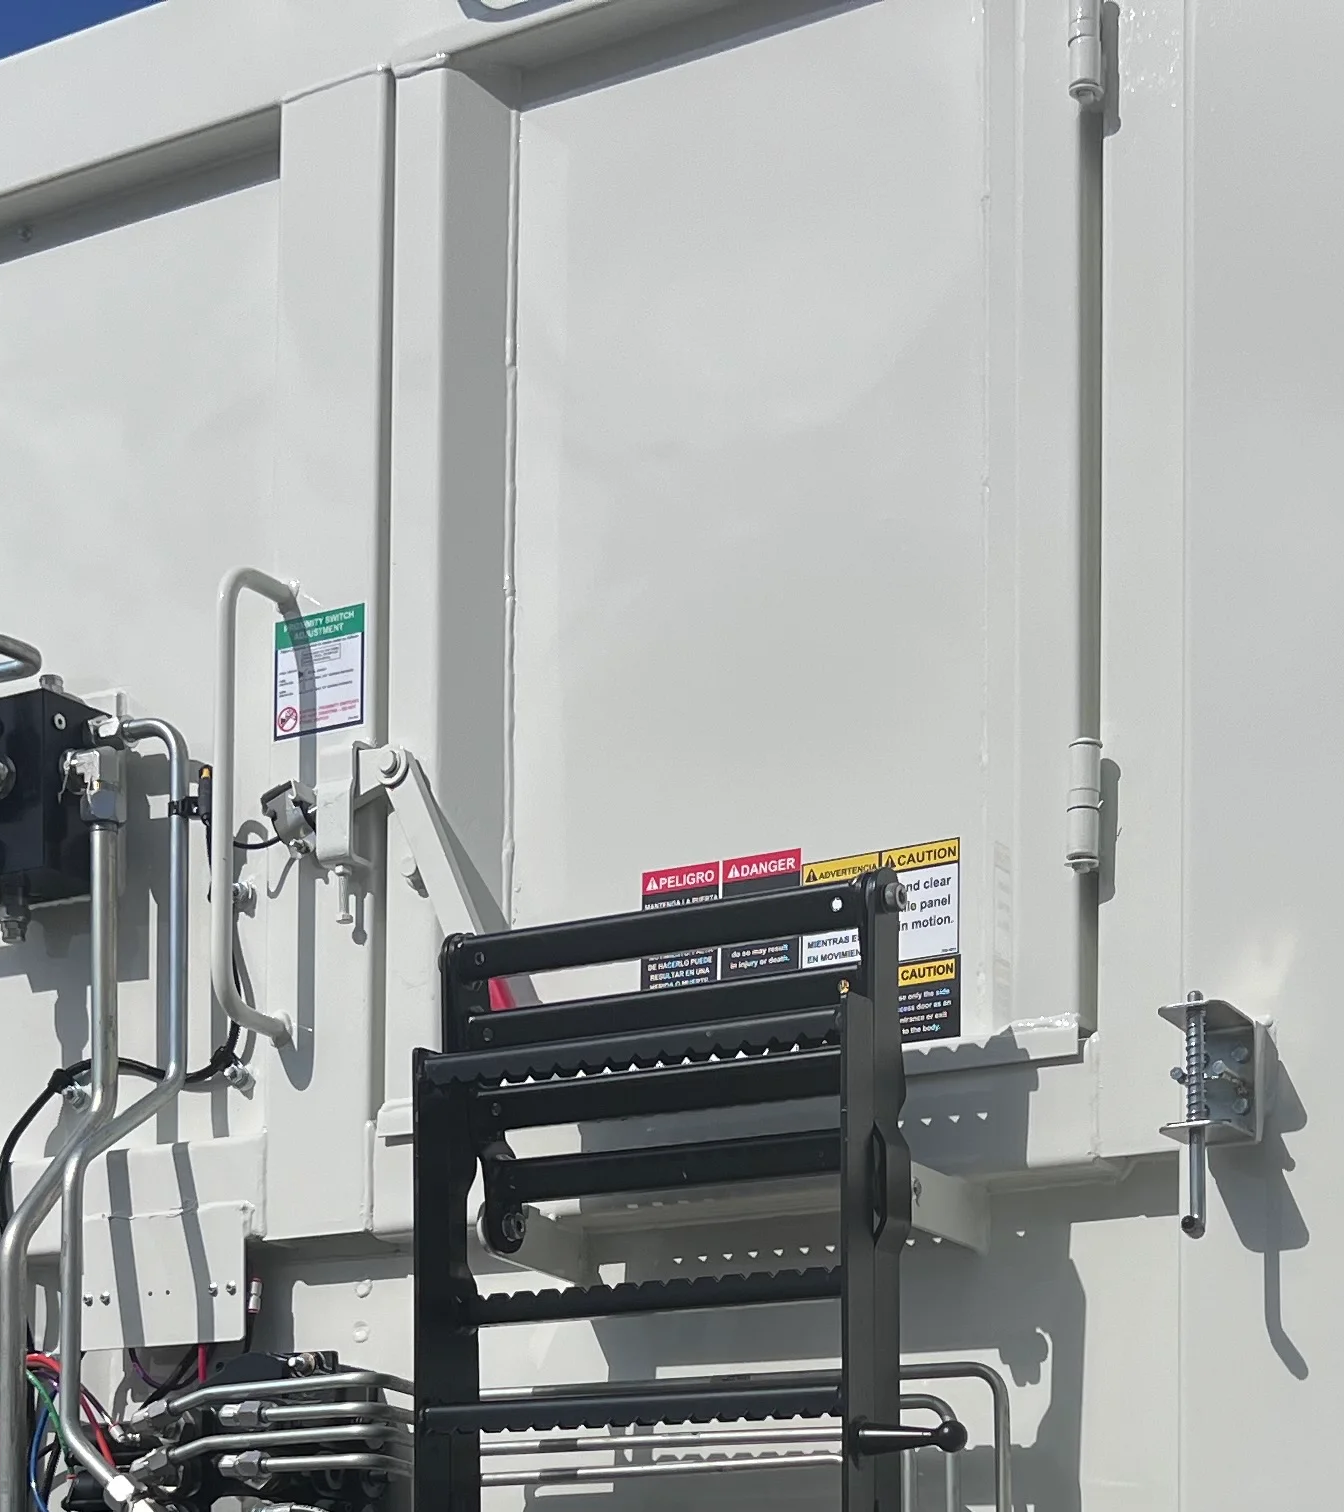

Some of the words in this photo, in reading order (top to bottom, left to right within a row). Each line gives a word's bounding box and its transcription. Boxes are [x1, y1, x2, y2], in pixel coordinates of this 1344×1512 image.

[325, 611, 354, 624] SWITCH
[897, 846, 957, 866] CAUTION
[741, 857, 795, 877] DANGER
[819, 863, 878, 880] ADVERTENCIA
[659, 871, 714, 889] PELIGRO
[923, 876, 952, 889] clear
[920, 894, 951, 912] panel
[911, 915, 954, 930] motion.
[807, 935, 850, 949] MIENTRAS
[820, 949, 861, 962] MOVIMIEN
[901, 963, 954, 981] CAUTION
